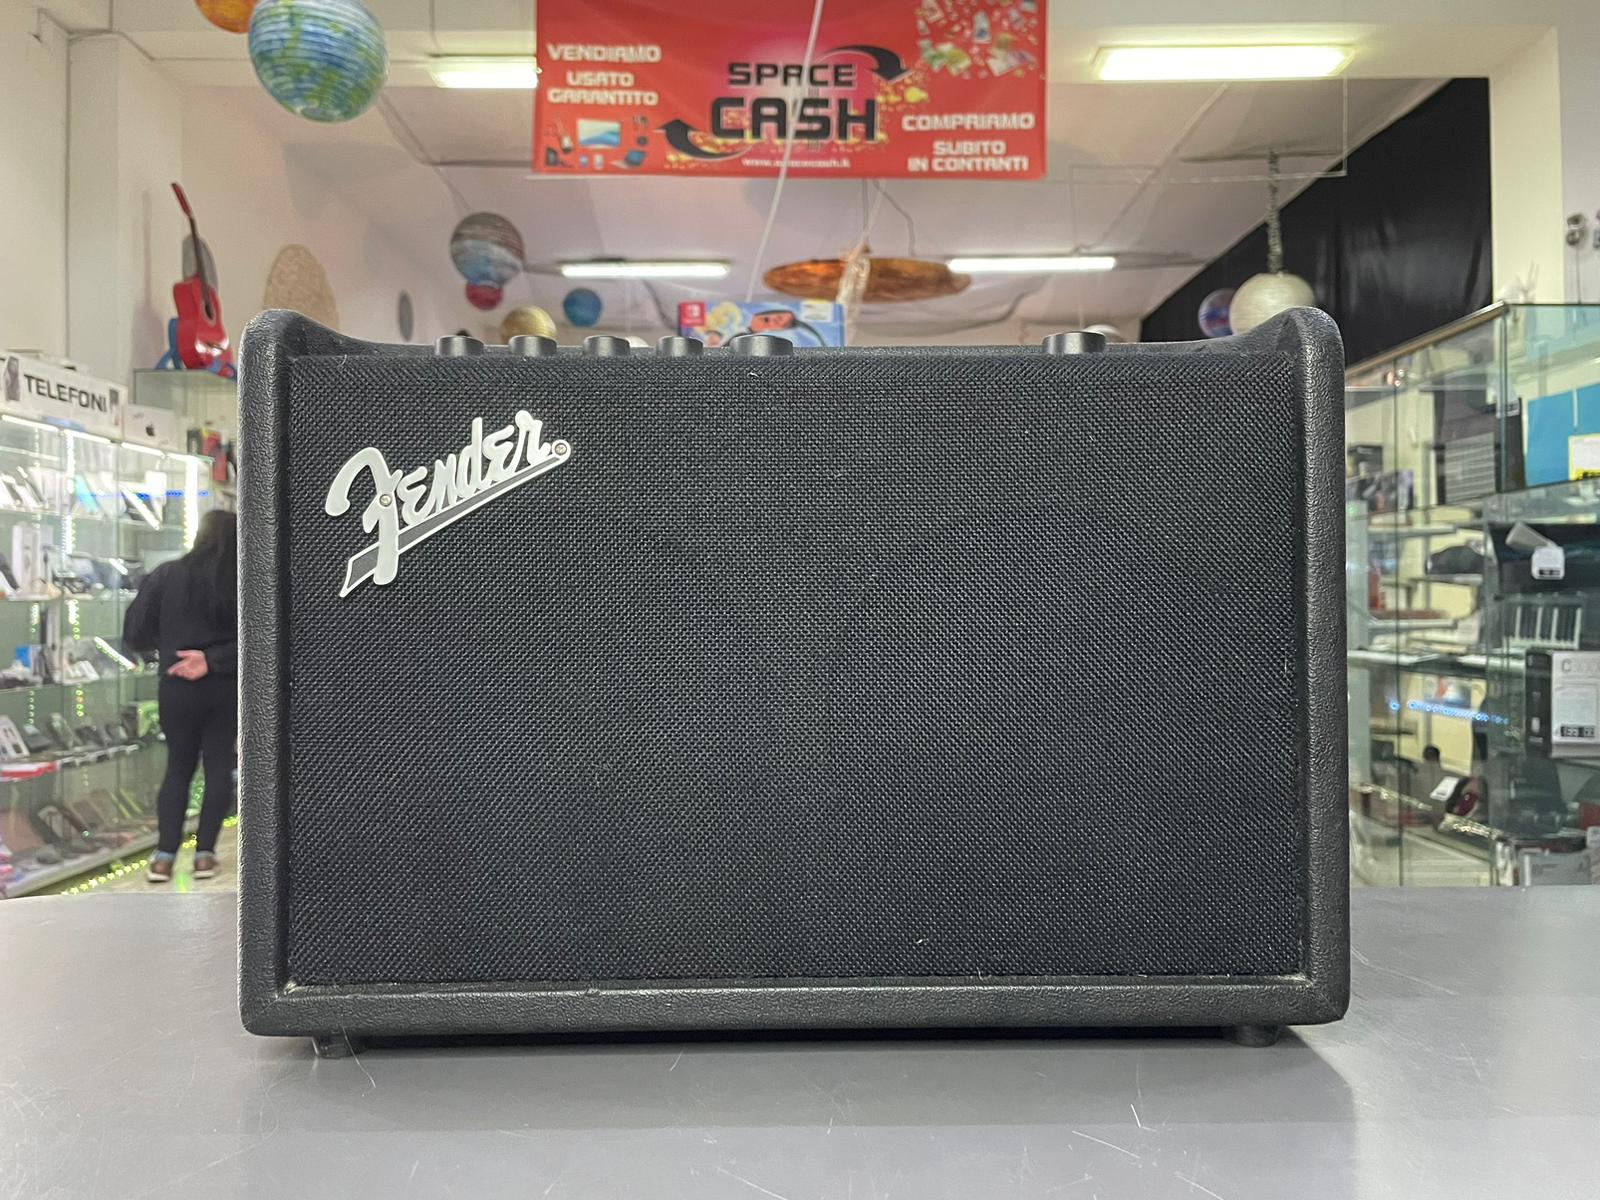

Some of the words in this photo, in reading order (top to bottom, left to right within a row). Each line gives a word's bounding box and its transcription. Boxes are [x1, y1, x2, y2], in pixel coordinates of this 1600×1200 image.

[546, 43, 661, 63] VENDIAMO
[566, 70, 634, 86] USATO
[728, 62, 853, 87] SPACE
[547, 87, 658, 106] GARANTITO
[711, 96, 877, 141] CASH
[901, 112, 1036, 131] COMPRIAMO
[932, 140, 1006, 156] SUBITO
[907, 156, 929, 172] IN
[931, 156, 1029, 172] CONTANTI
[23, 373, 108, 413] TELEFONI
[325, 409, 560, 586] Fender
